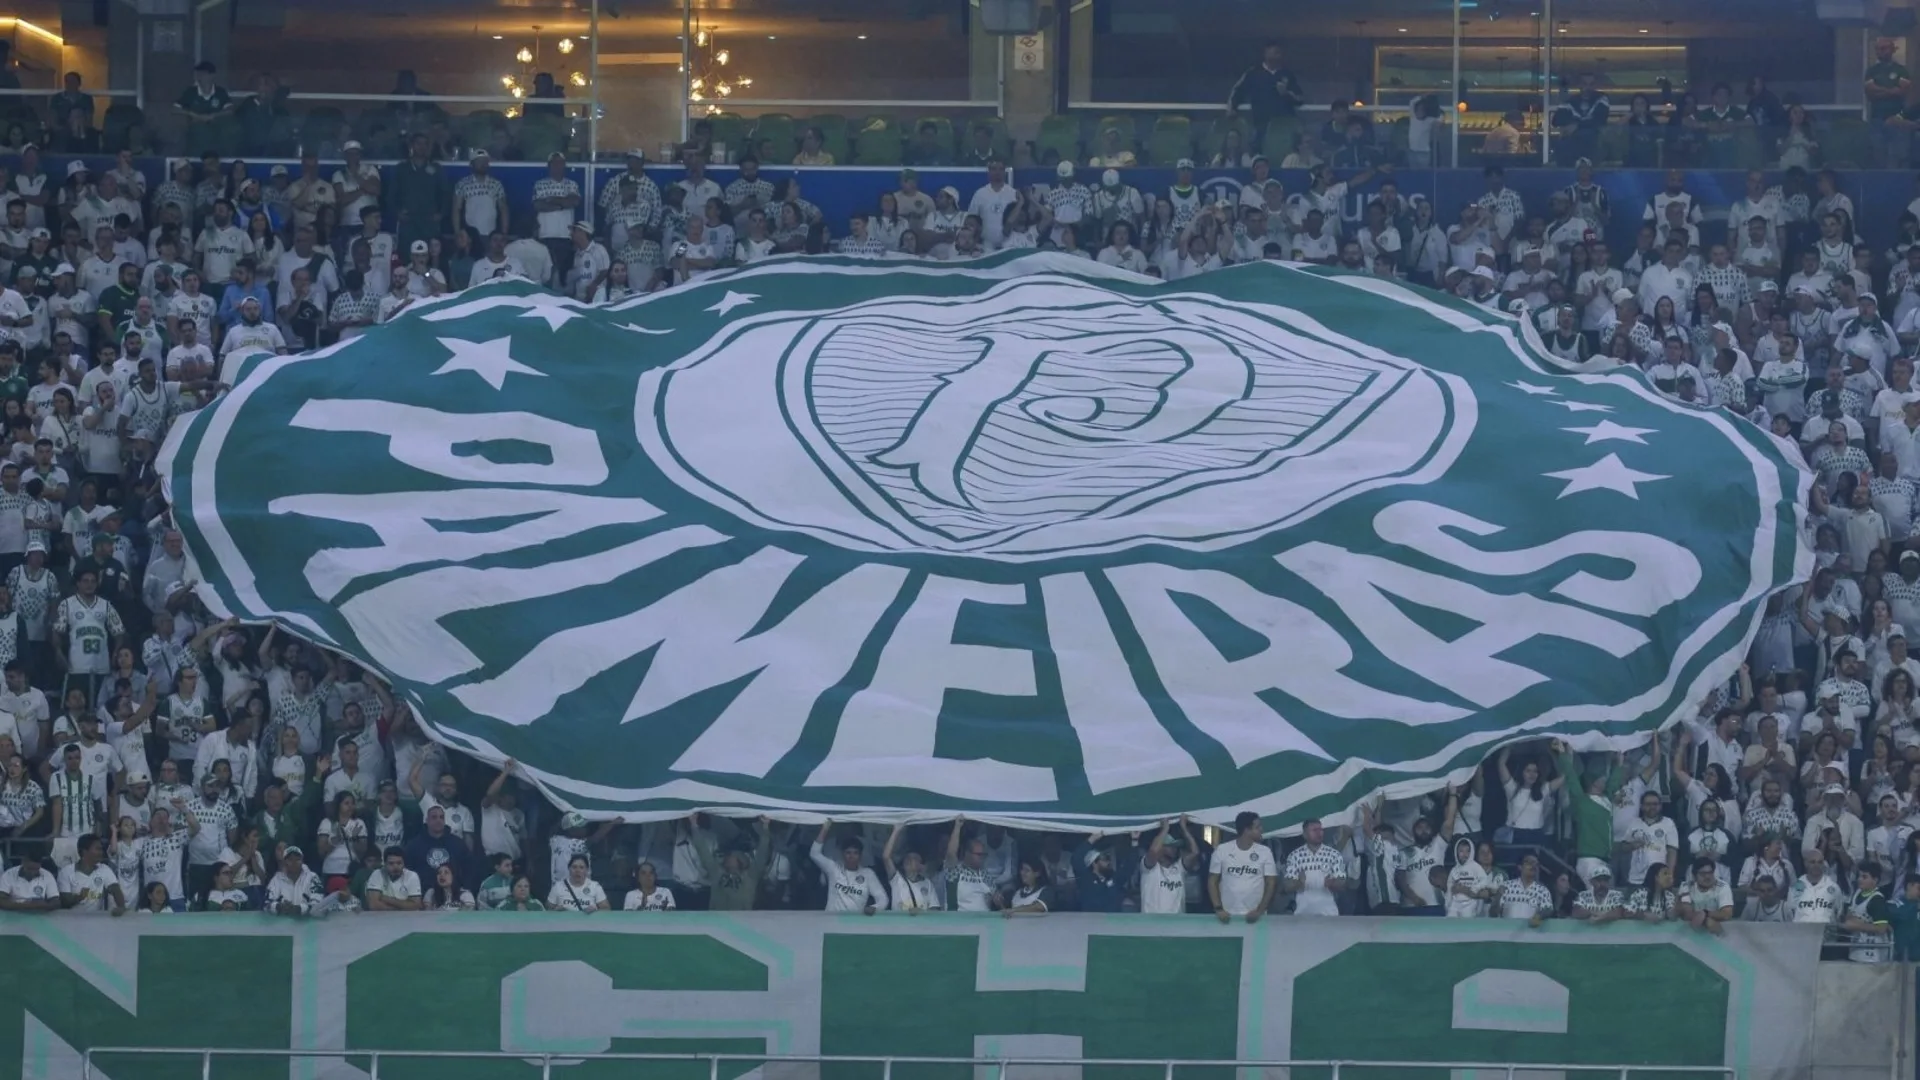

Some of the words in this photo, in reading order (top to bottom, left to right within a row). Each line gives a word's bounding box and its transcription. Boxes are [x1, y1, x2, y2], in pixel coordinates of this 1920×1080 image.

[267, 397, 1703, 803] PALMEIRAS
[82, 638, 102, 655] 83
[1227, 864, 1258, 876] crefisa
[1406, 857, 1435, 872] crefisa
[835, 882, 863, 896] crefisa
[1798, 897, 1835, 911] crefisa
